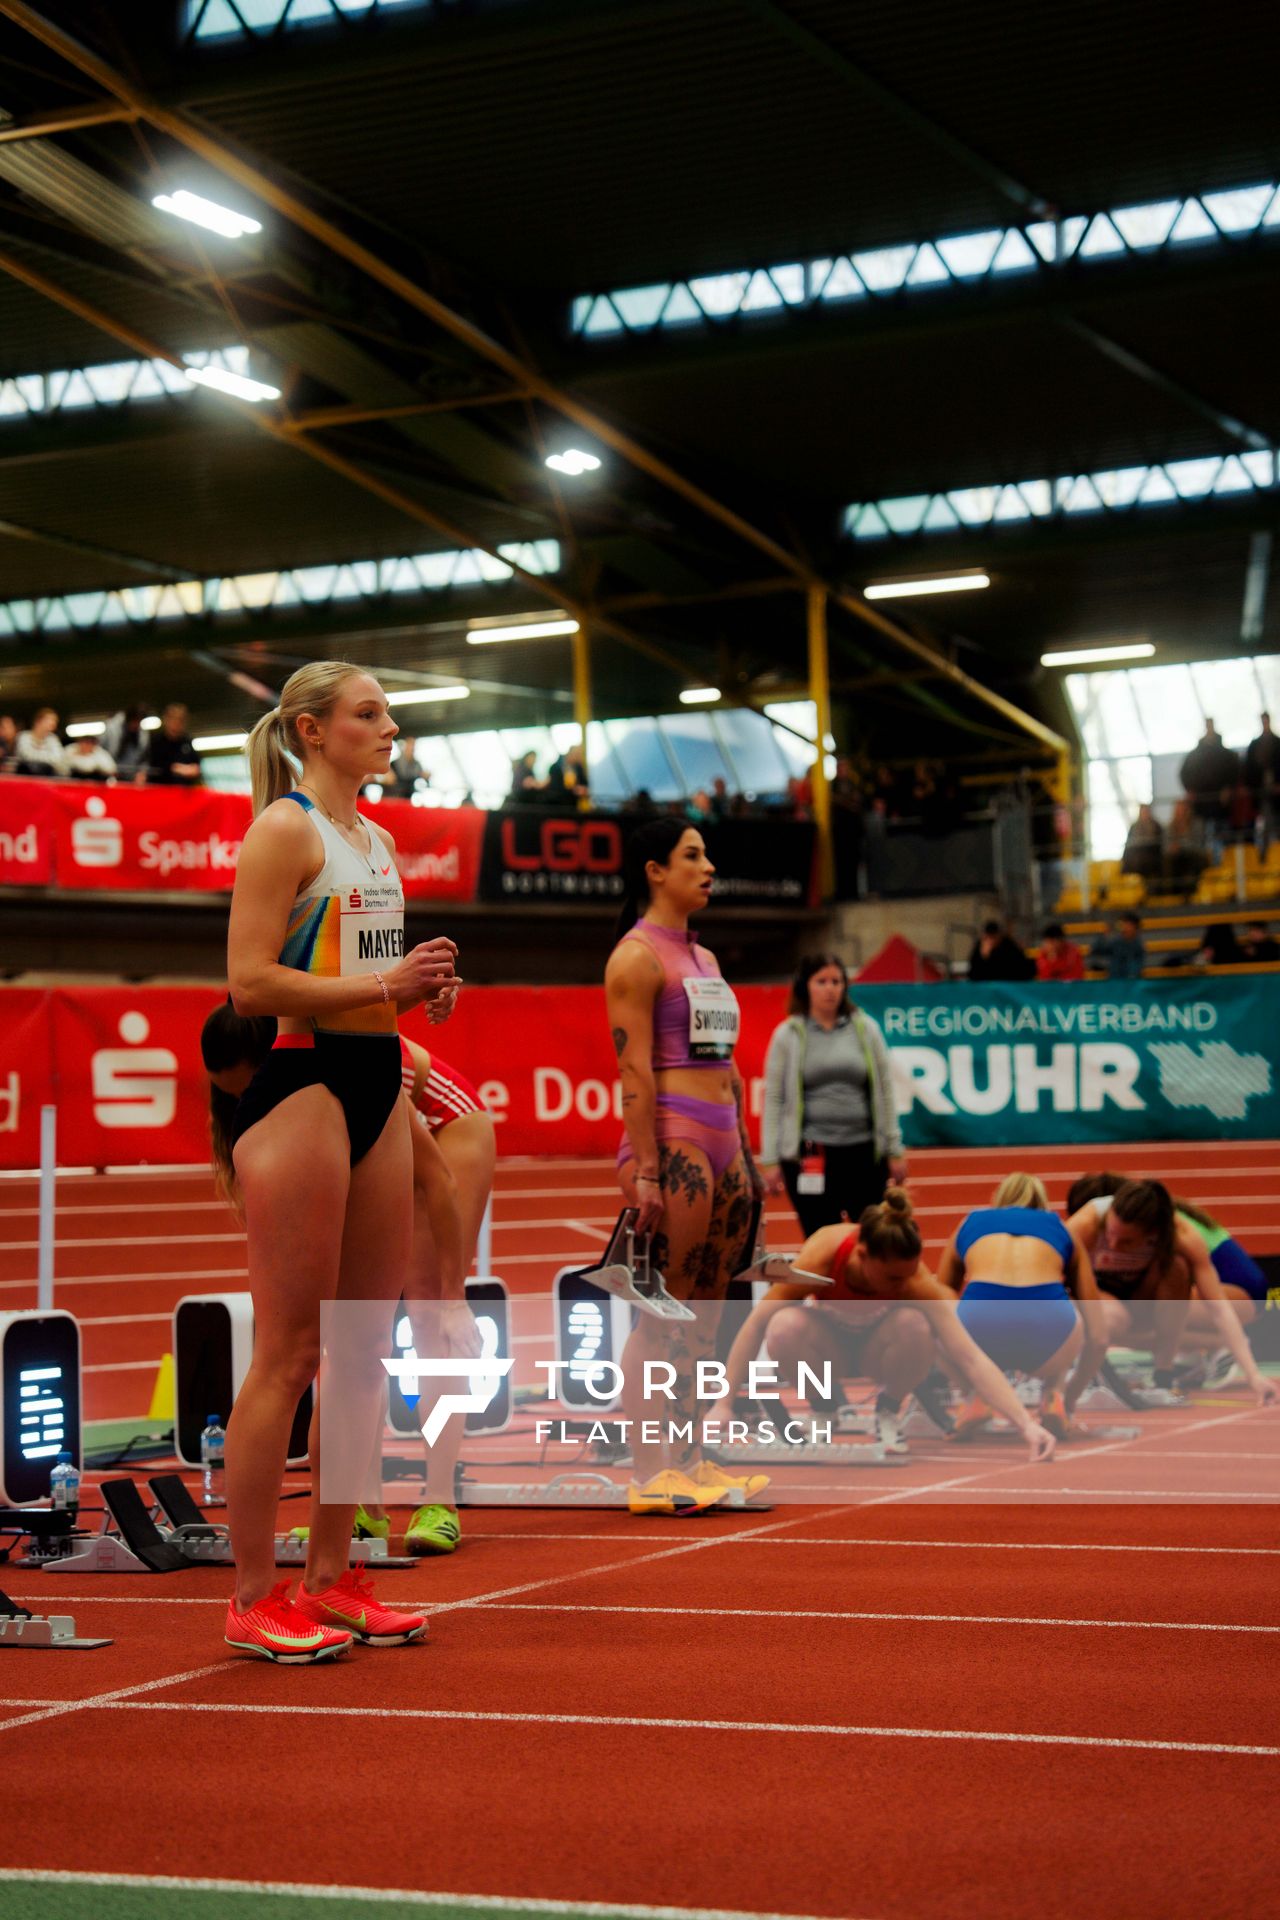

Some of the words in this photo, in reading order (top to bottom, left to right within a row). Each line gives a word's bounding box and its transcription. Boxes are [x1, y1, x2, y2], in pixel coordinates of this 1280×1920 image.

[502, 818, 622, 873] LGO
[363, 887, 380, 897] Indoor
[380, 886, 399, 897] Meeting
[502, 871, 625, 895] DORTMUND
[364, 899, 389, 908] Dortmund
[883, 1002, 1218, 1037] REGIONALVERBAND
[889, 1042, 1147, 1117] RUHR
